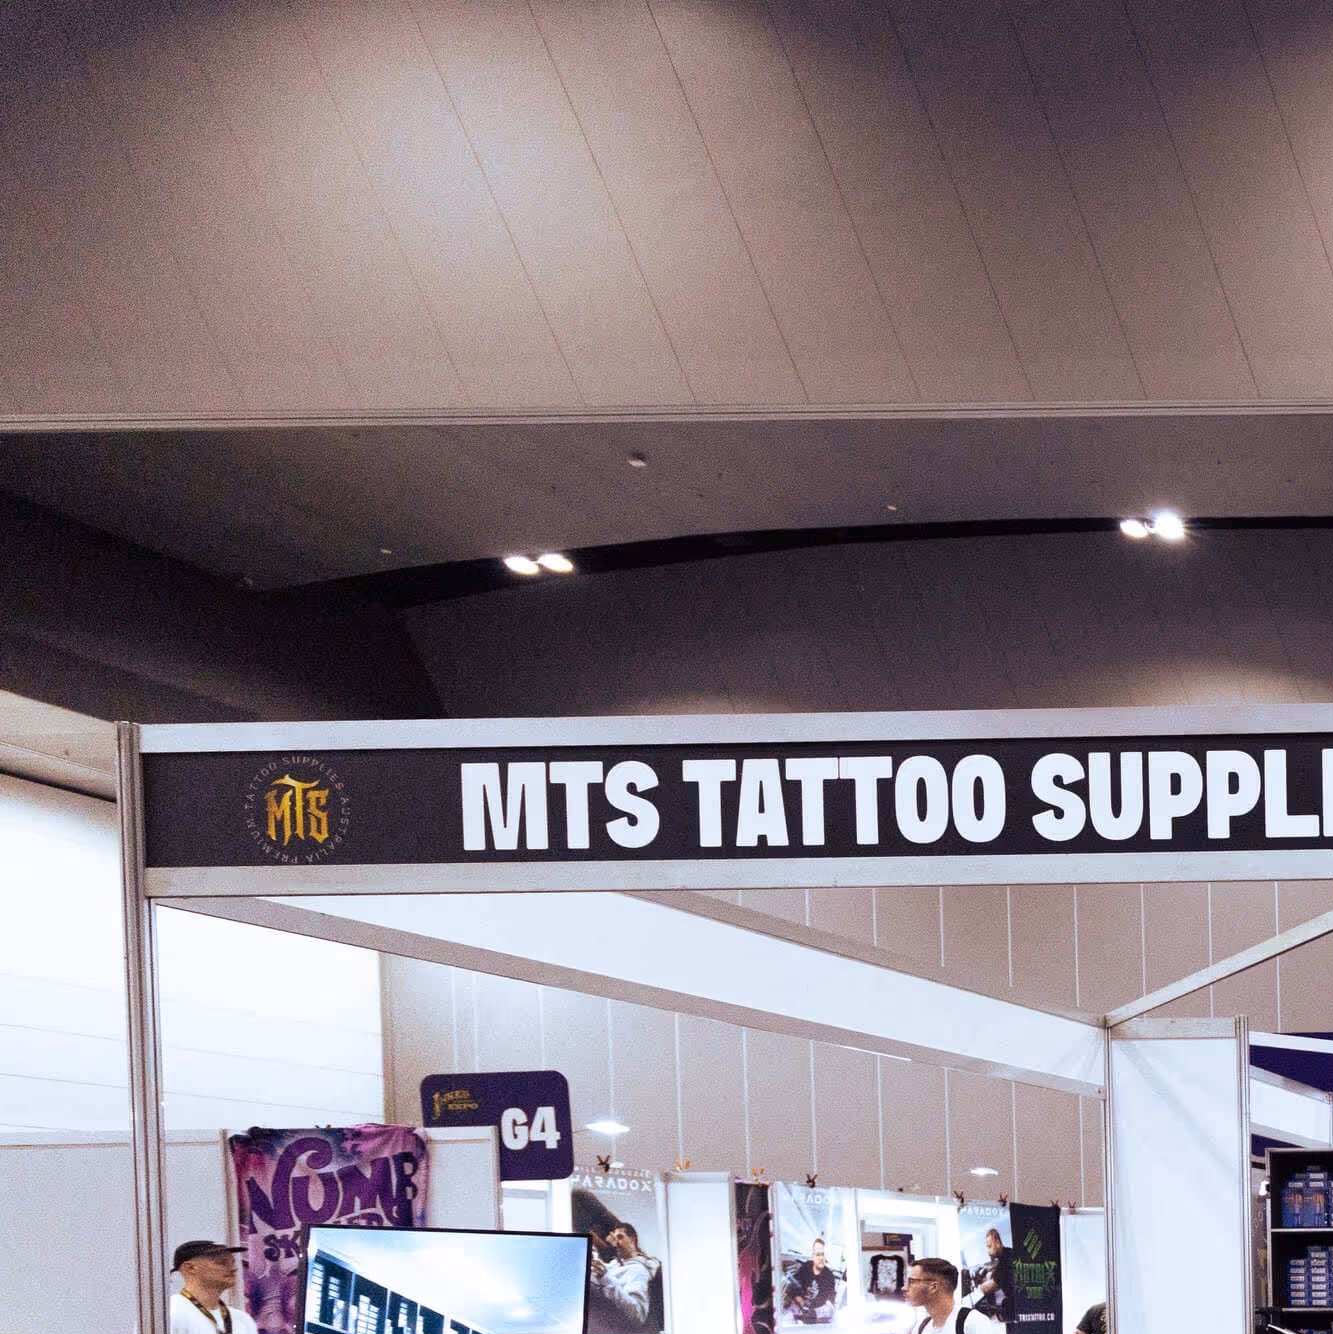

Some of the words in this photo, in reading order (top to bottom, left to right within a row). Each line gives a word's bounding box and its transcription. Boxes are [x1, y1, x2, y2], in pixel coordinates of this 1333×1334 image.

[264, 774, 329, 846] MTS
[461, 761, 659, 850] MTS
[683, 755, 1005, 847] TATTOO
[501, 1106, 561, 1150] G4
